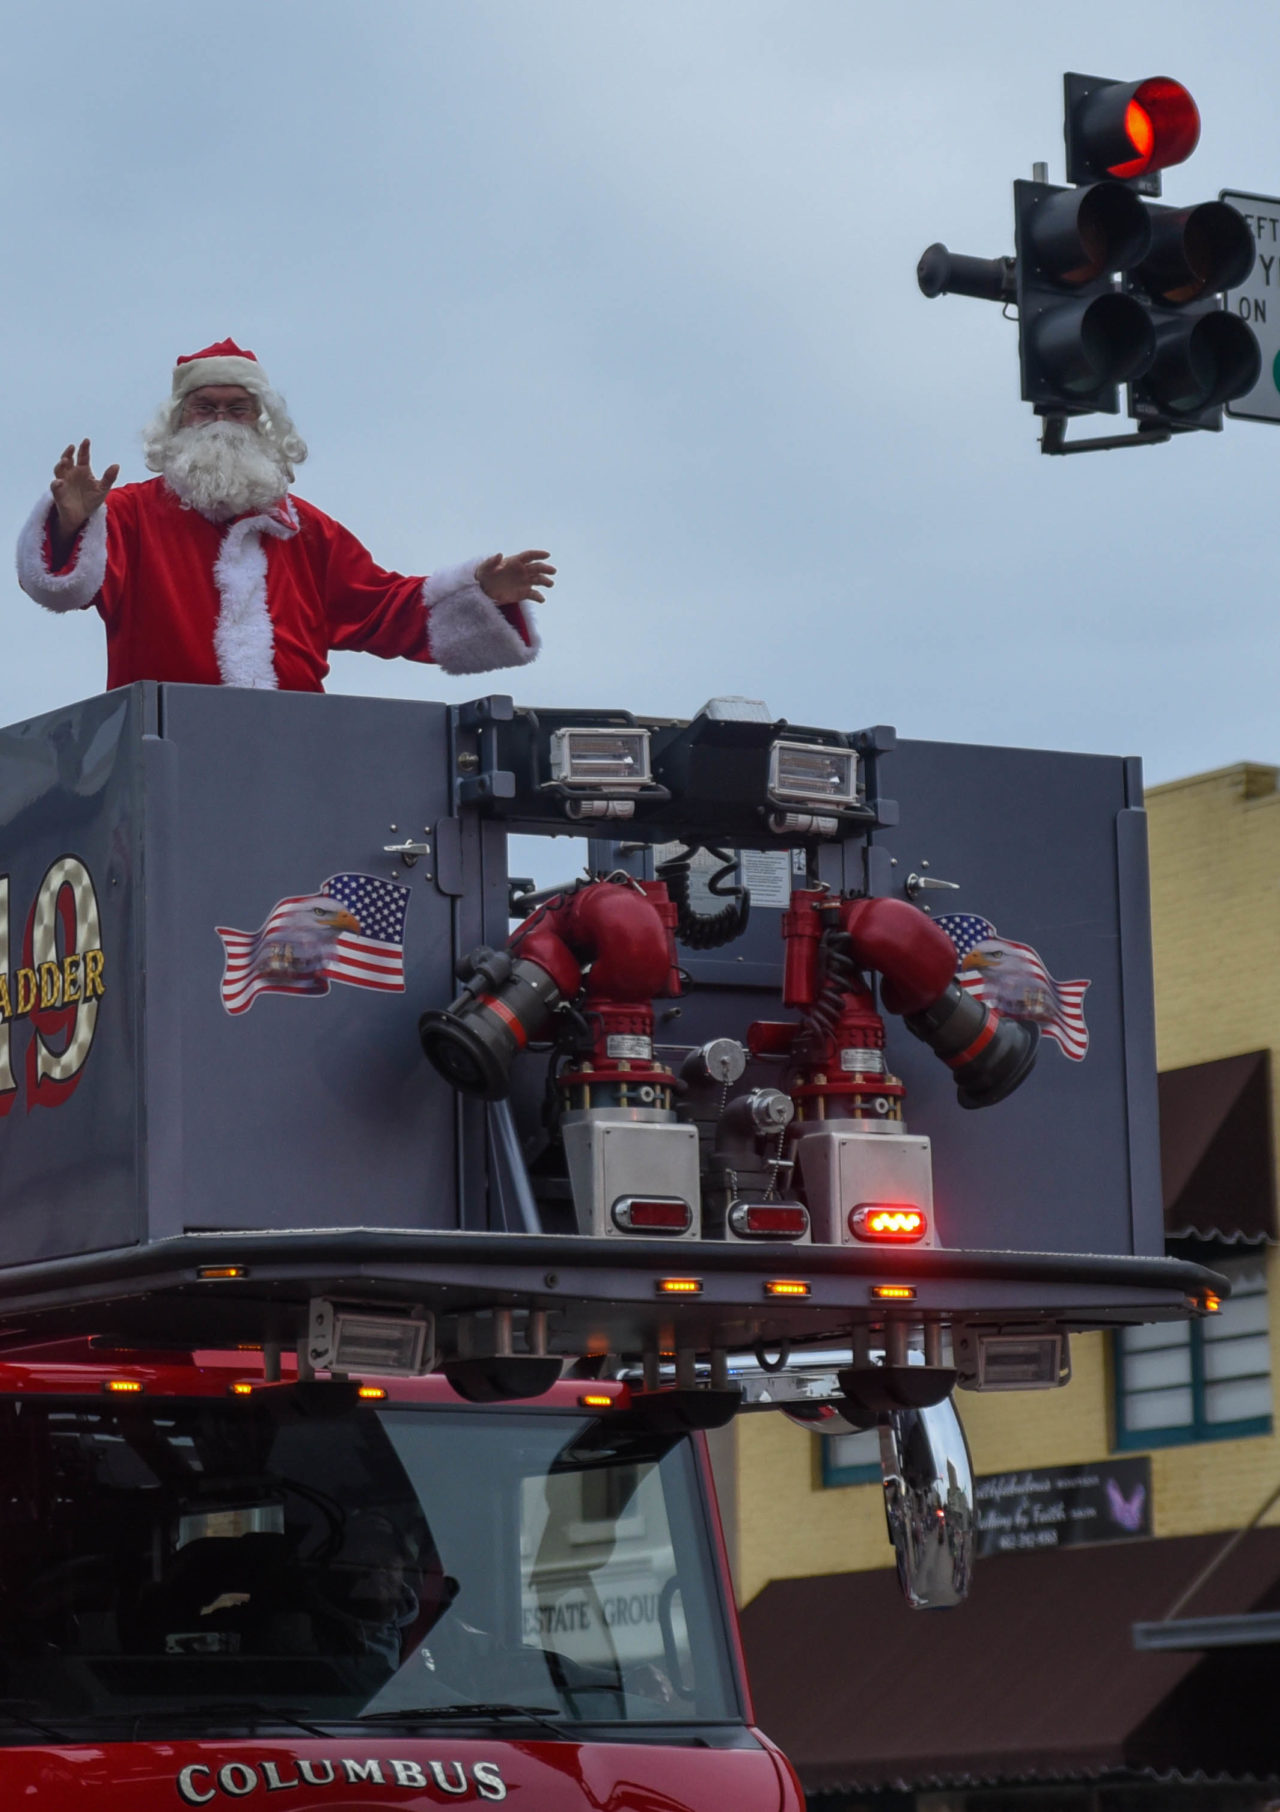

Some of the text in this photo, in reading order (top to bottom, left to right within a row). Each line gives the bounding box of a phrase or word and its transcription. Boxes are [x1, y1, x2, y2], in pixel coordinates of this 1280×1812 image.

[1239, 297, 1267, 324] ON
[521, 1601, 591, 1637] ESTATE
[177, 1758, 508, 1805] COLUMBUS
